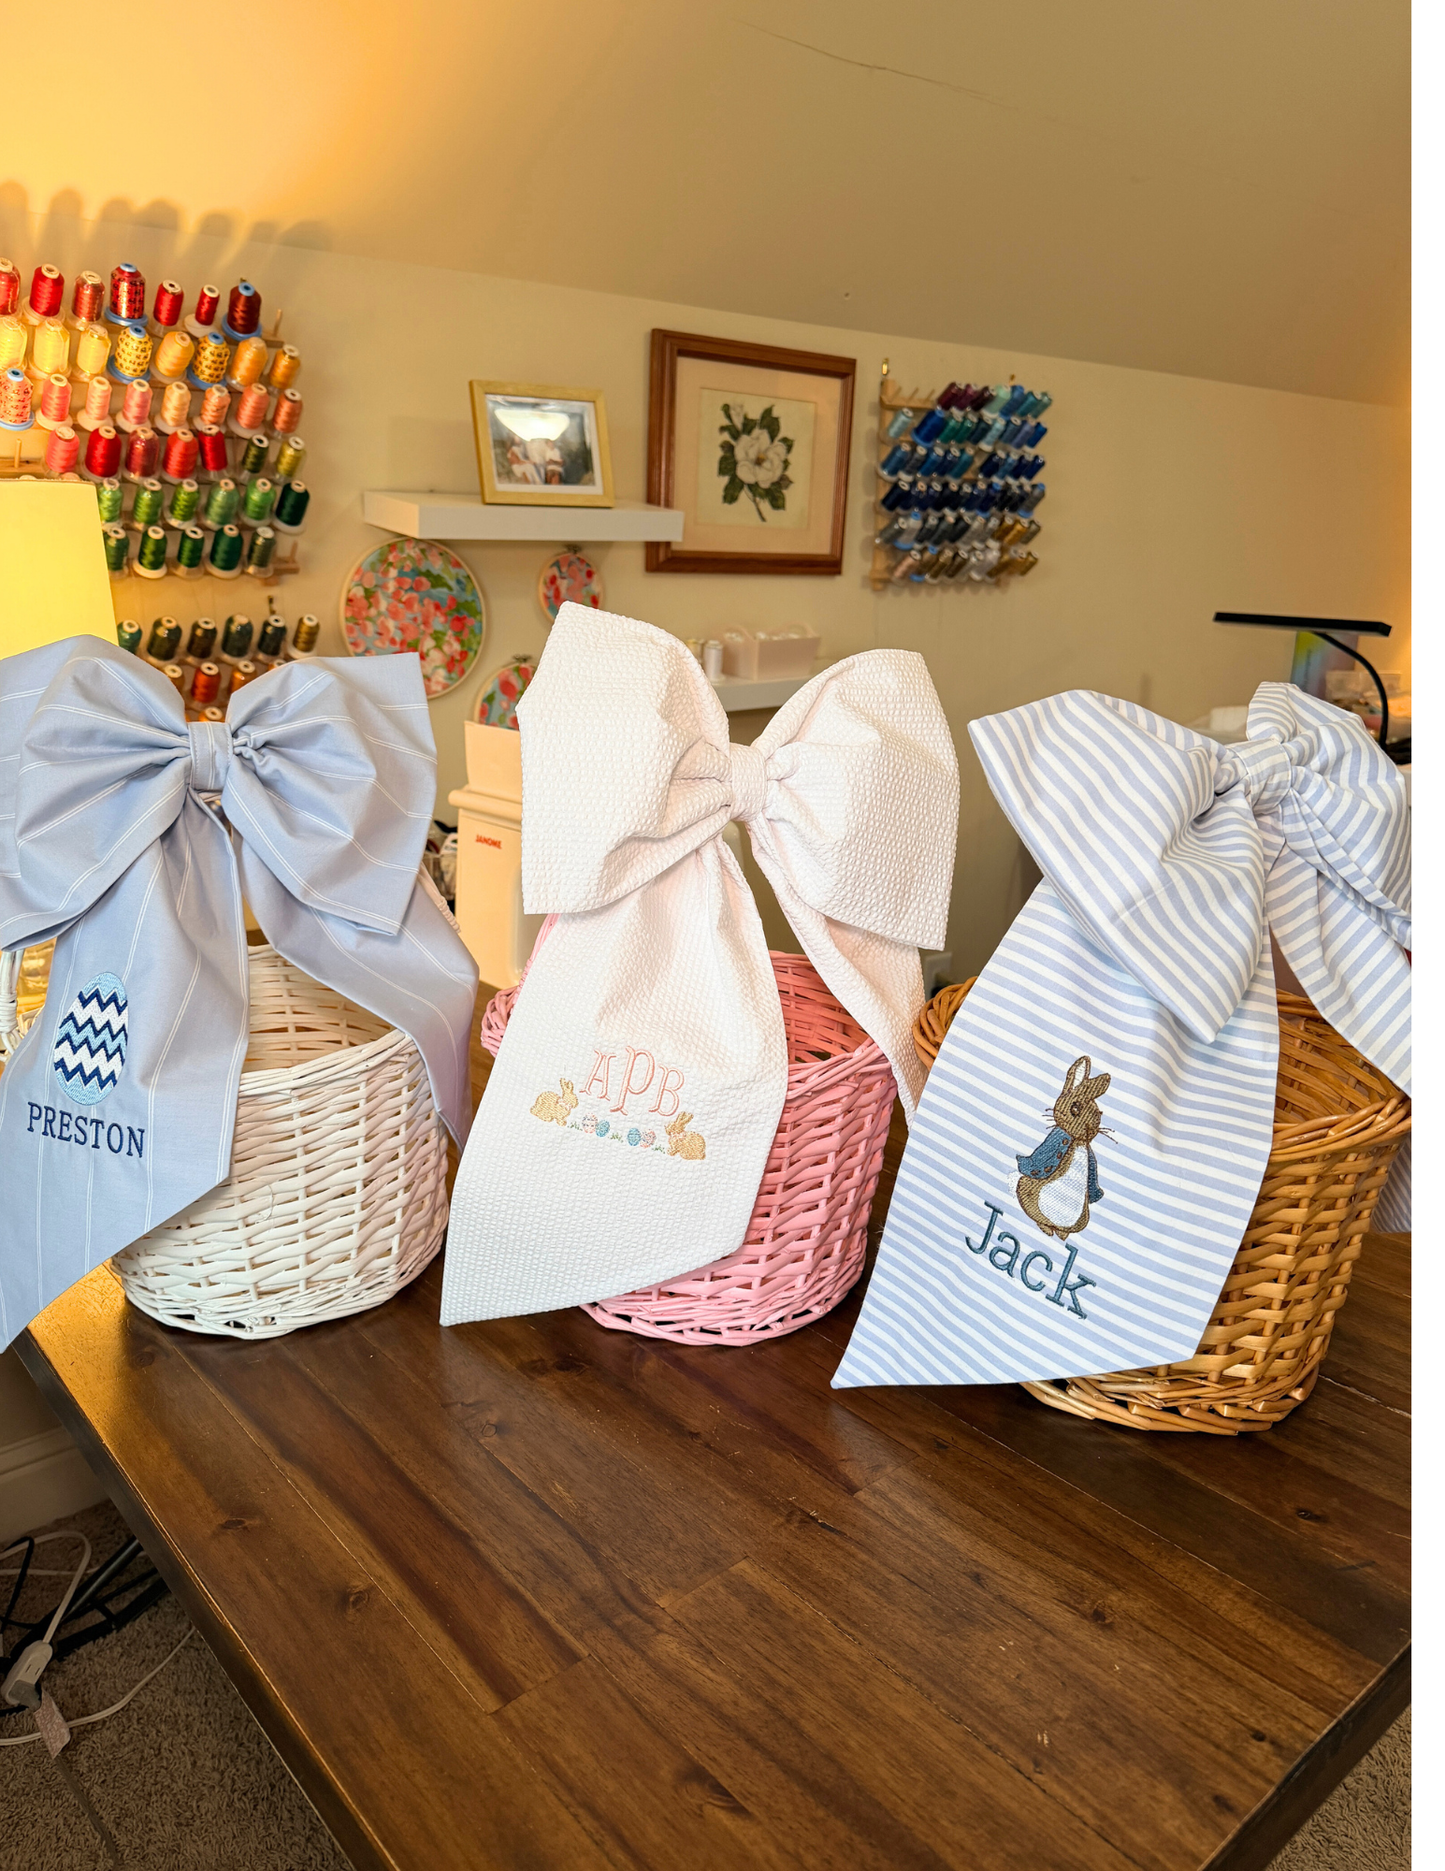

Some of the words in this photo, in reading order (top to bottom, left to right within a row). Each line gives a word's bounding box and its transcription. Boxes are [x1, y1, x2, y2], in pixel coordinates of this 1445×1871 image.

[475, 834, 502, 849] JANOME
[579, 1045, 685, 1116] APB
[27, 1101, 145, 1158] PRESTON
[965, 1200, 1097, 1320] Jack
